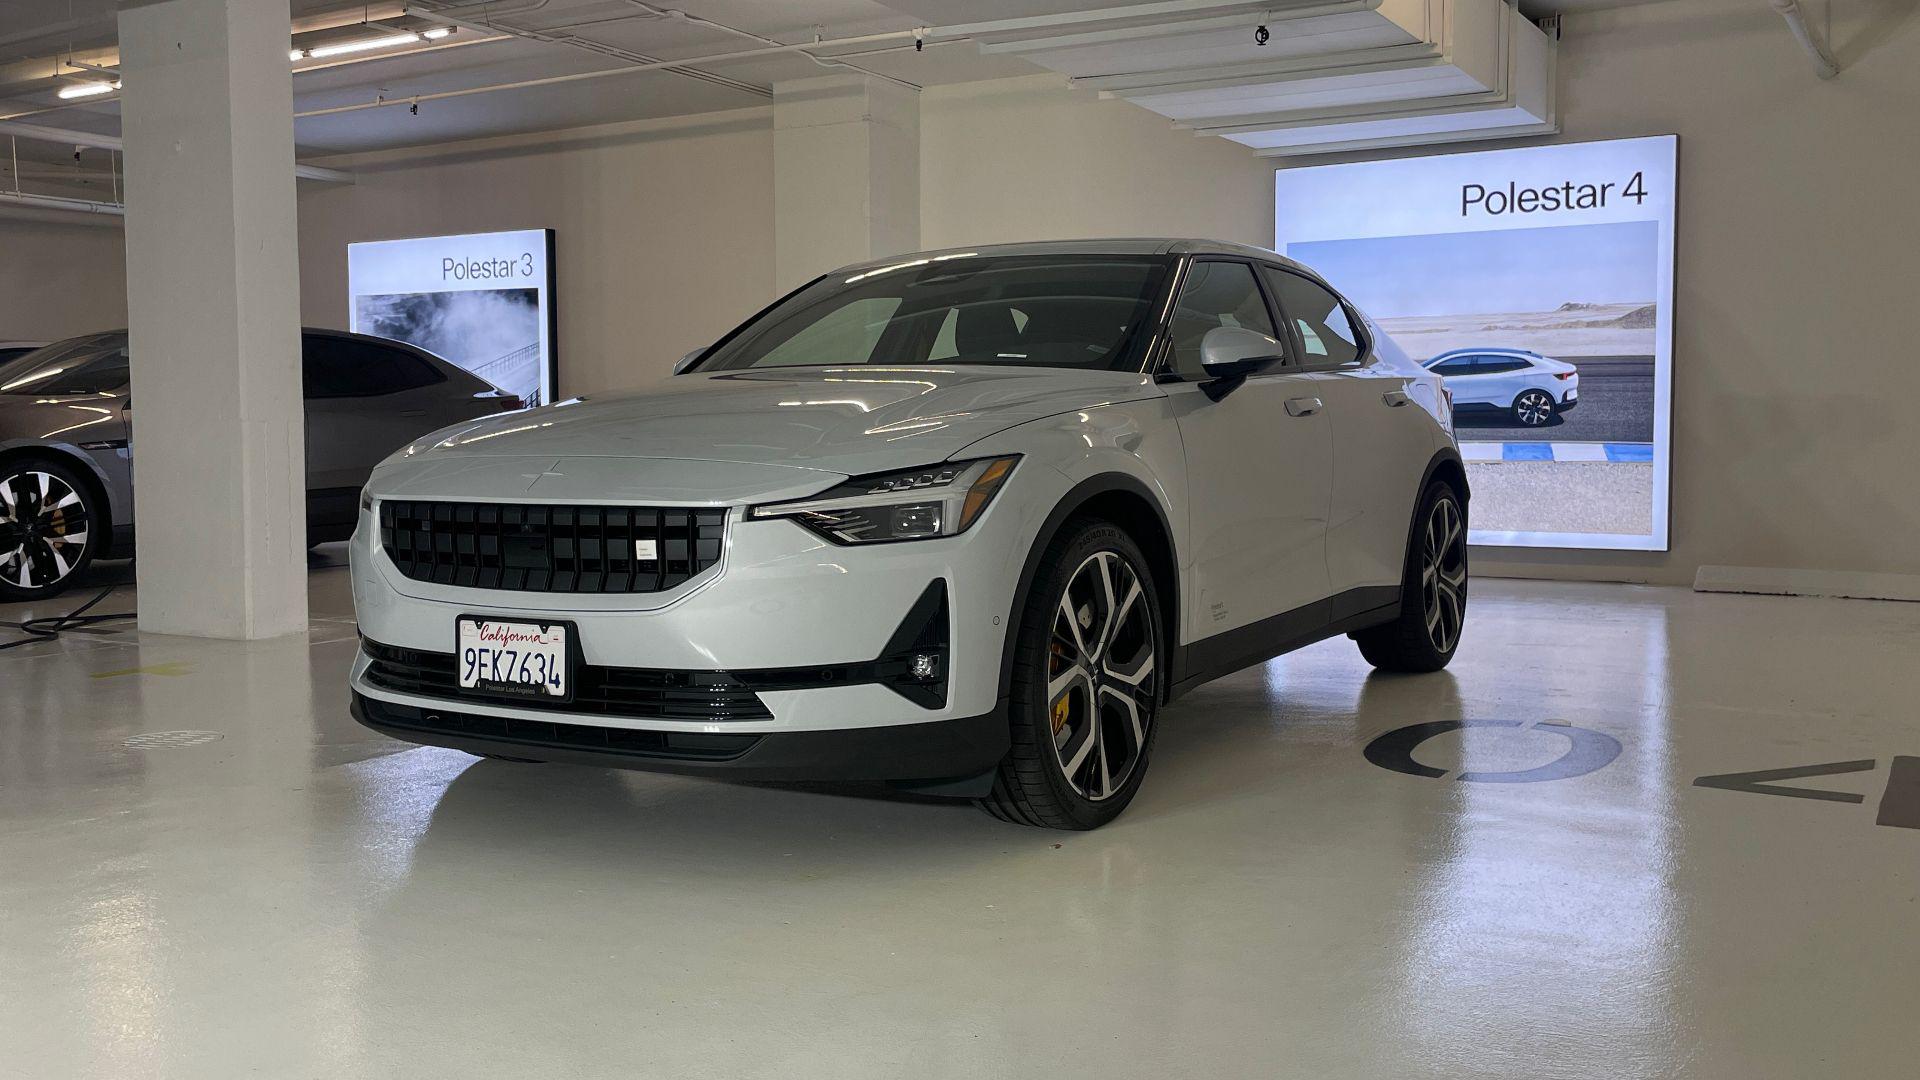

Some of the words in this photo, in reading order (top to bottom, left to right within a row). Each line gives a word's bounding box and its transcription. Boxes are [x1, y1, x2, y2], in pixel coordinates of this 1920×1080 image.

[1461, 180, 1615, 217] Polestar
[1622, 171, 1649, 205] 4
[442, 255, 517, 281] Polestar
[521, 252, 533, 277] 3
[480, 624, 548, 648] California
